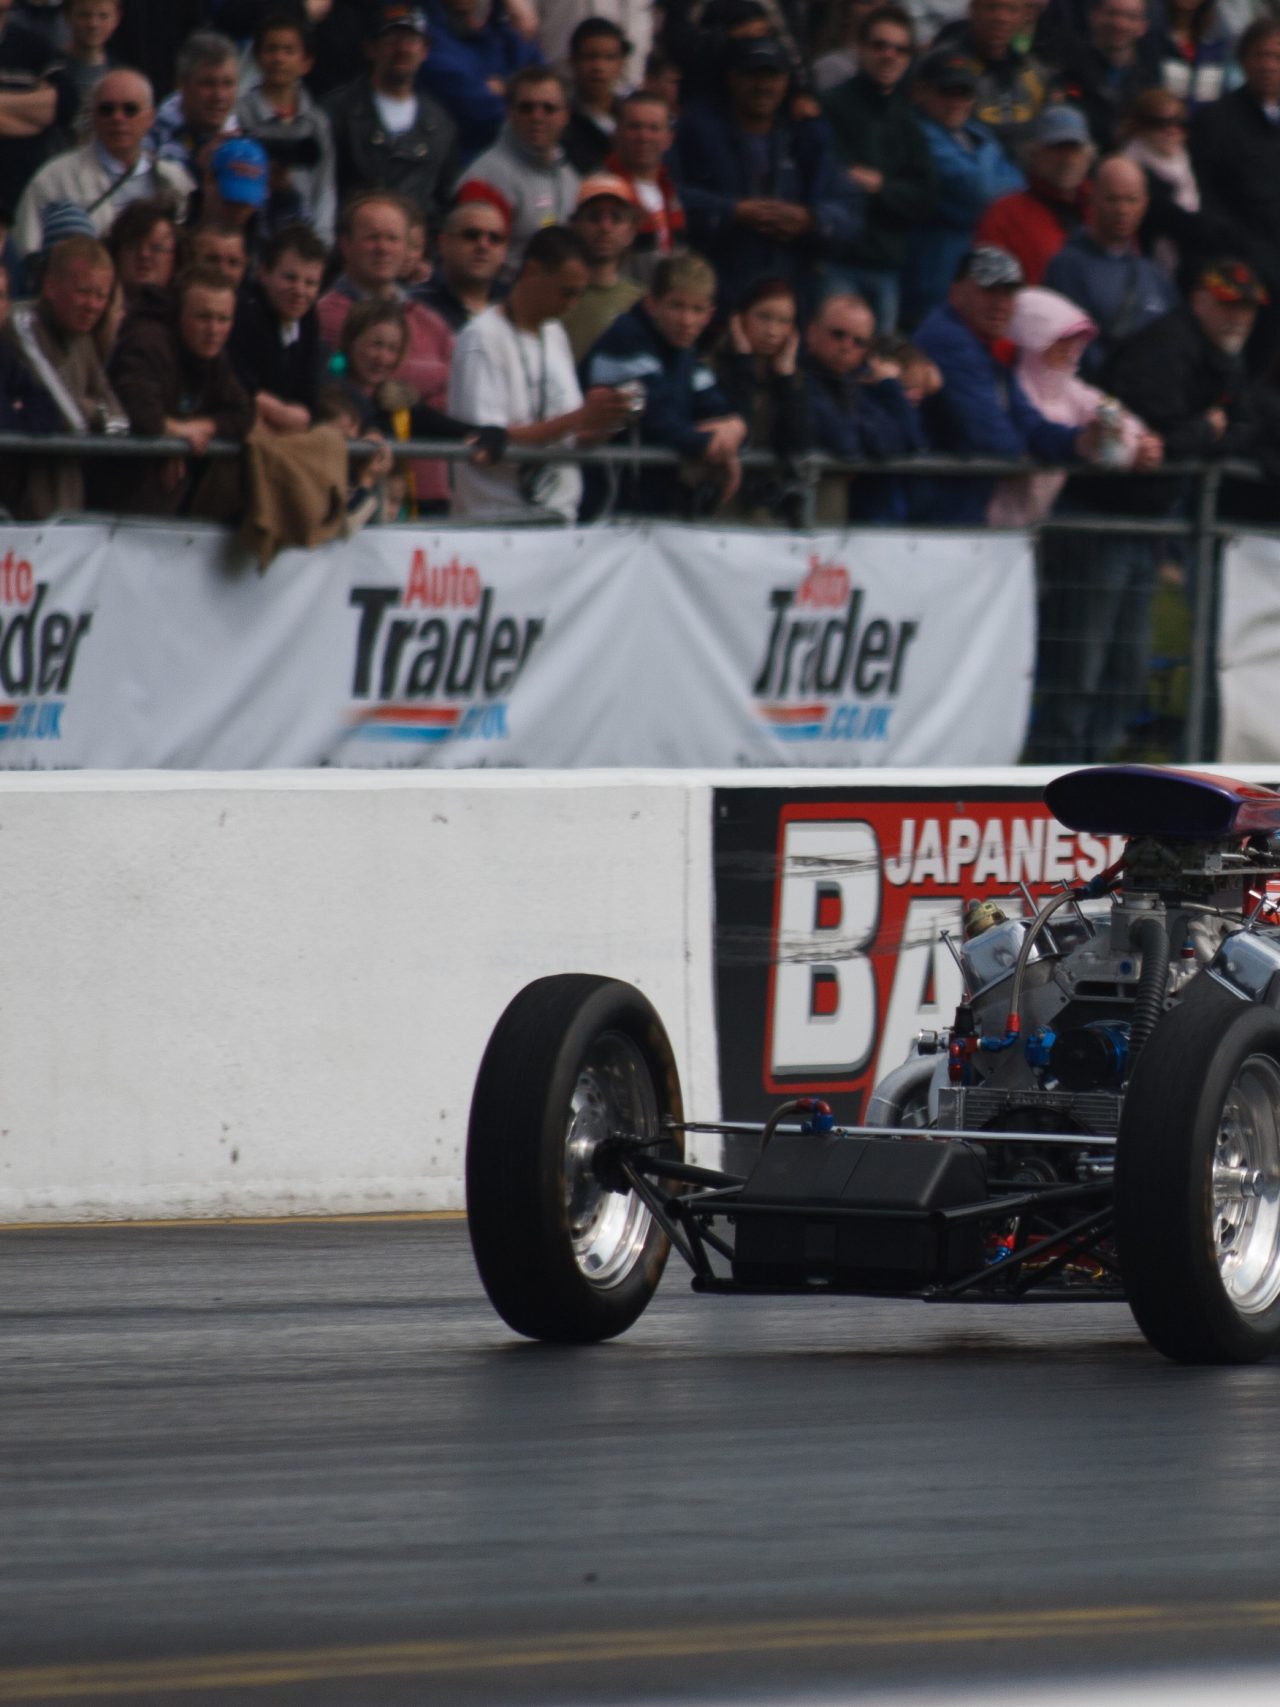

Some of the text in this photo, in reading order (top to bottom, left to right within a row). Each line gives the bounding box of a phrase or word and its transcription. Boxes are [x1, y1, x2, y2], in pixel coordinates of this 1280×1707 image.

[0, 547, 33, 606] to
[404, 548, 481, 608] Auto
[0, 581, 94, 697] der
[350, 587, 547, 699] Trader
